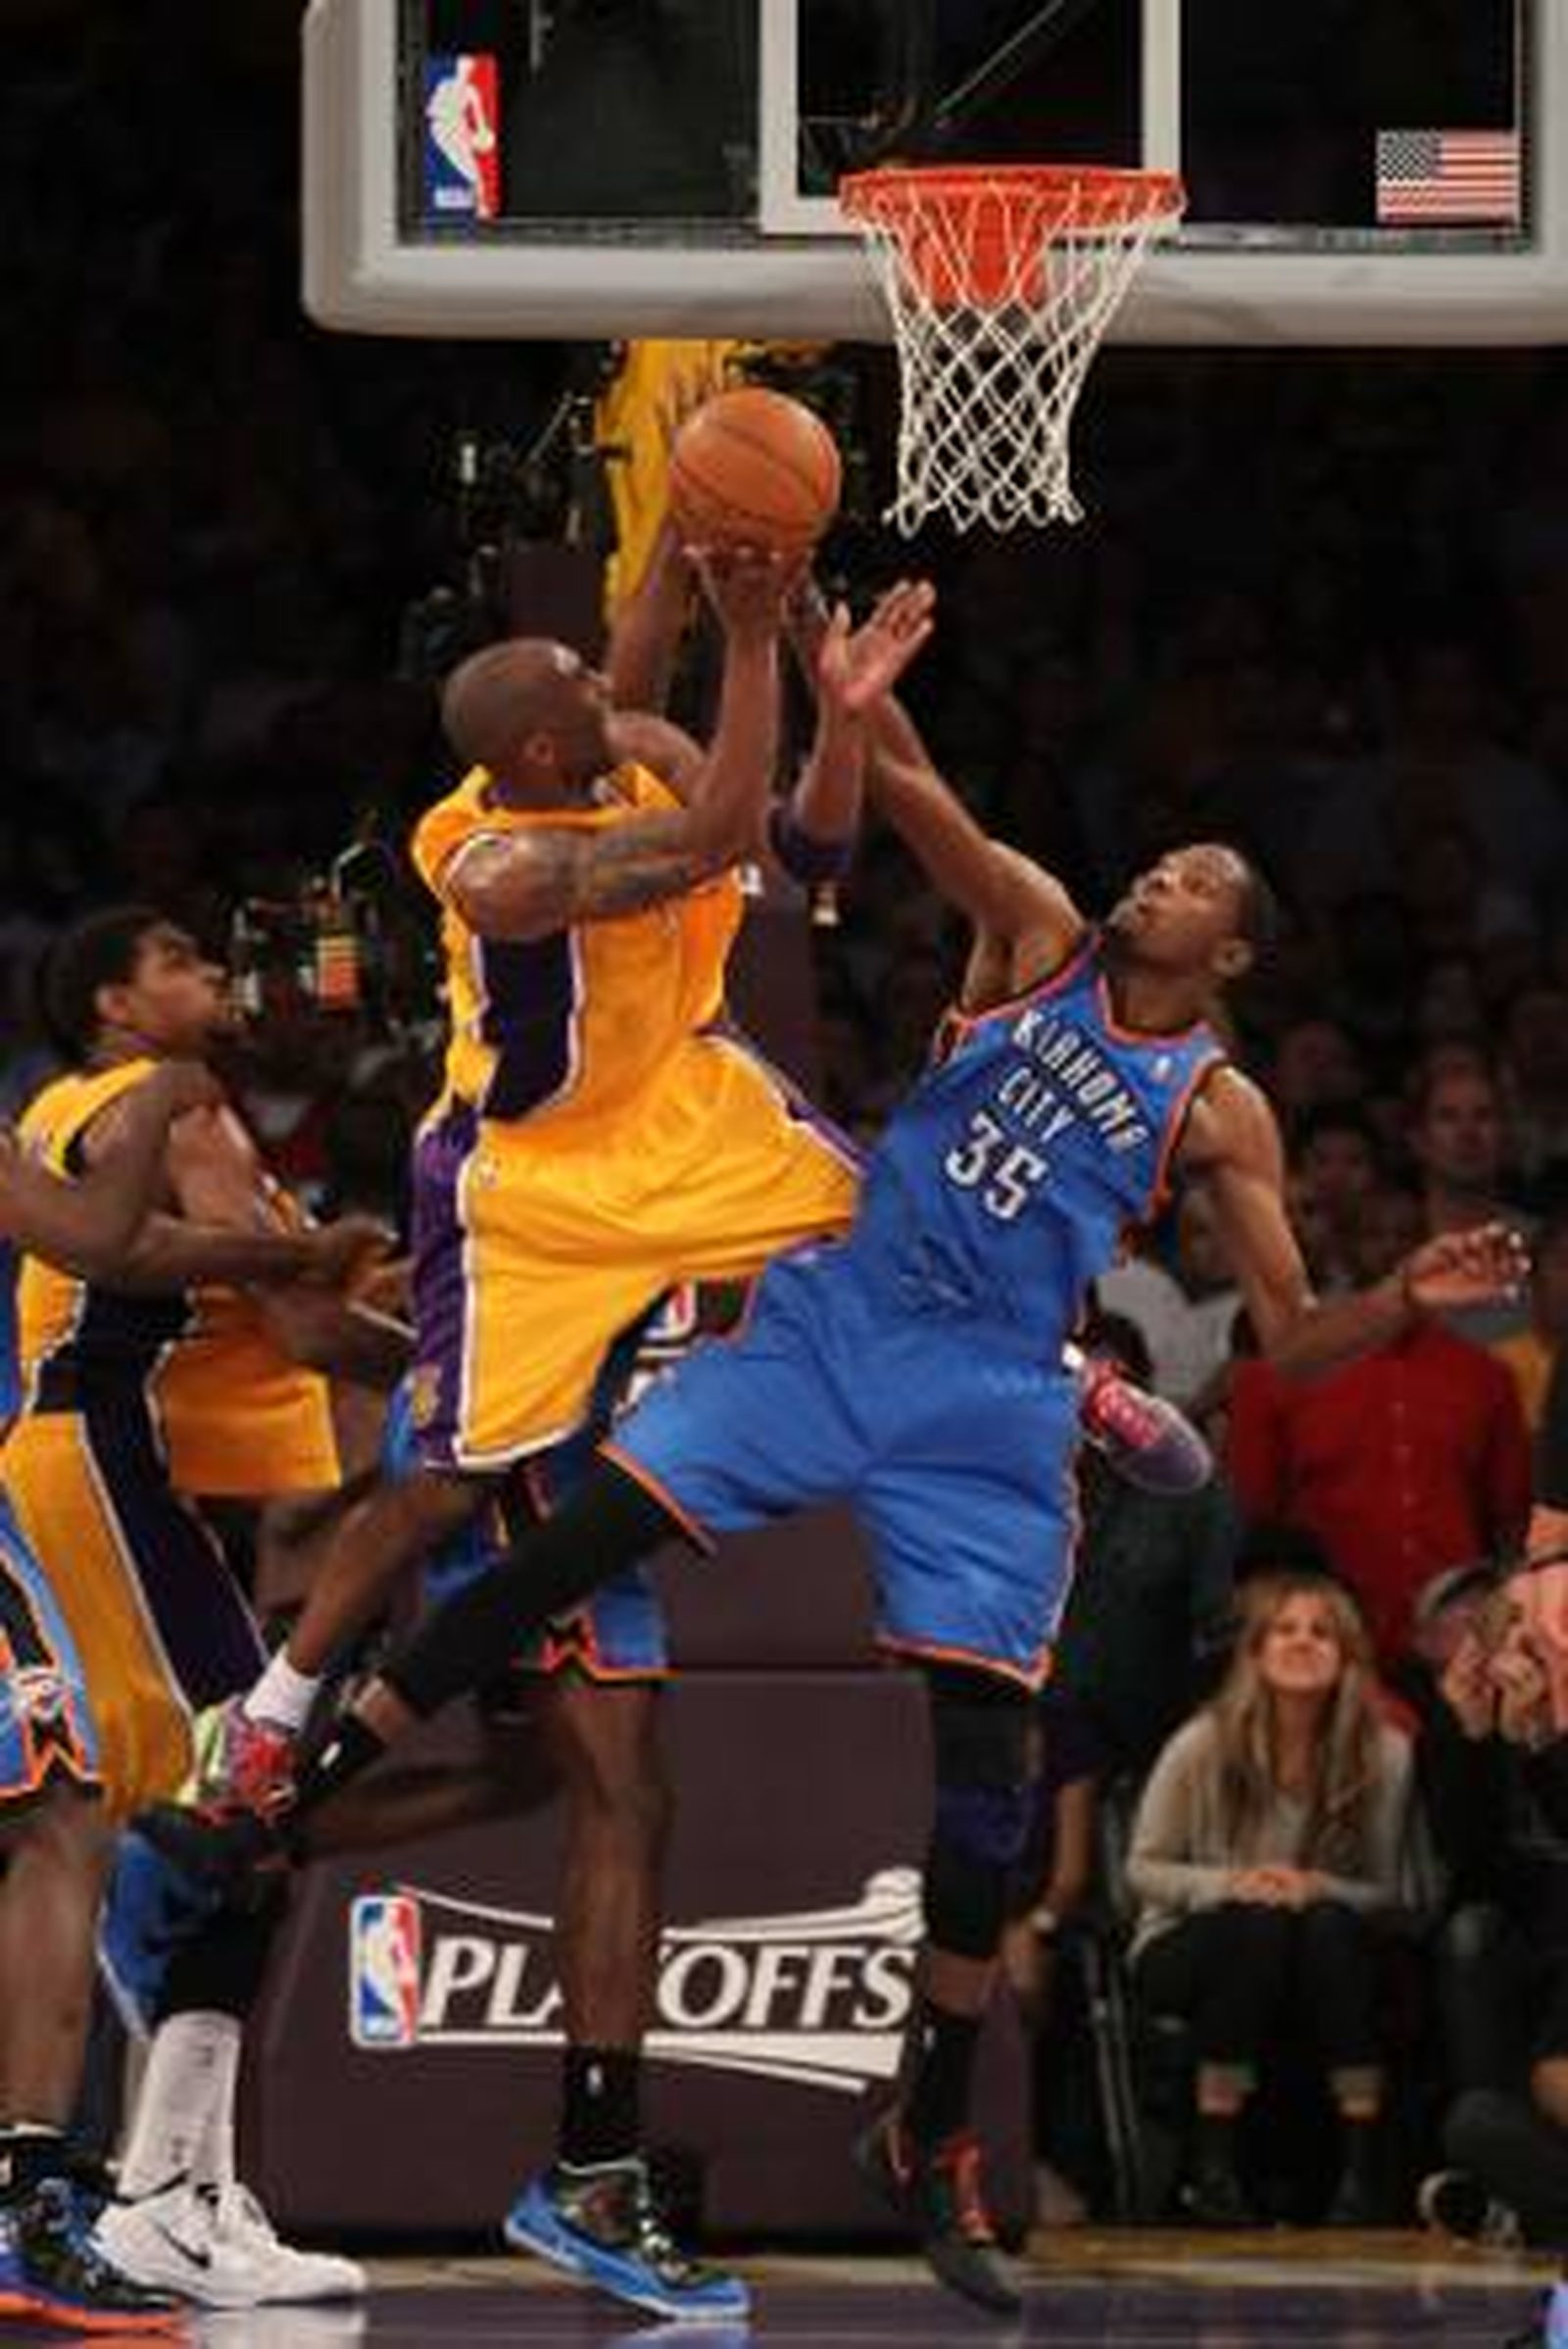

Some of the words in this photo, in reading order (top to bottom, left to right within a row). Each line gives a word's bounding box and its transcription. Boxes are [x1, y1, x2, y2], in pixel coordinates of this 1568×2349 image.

[999, 1067, 1076, 1144] CITY
[946, 1112, 1049, 1219] 35
[421, 1936, 916, 2028] PLOFFS
